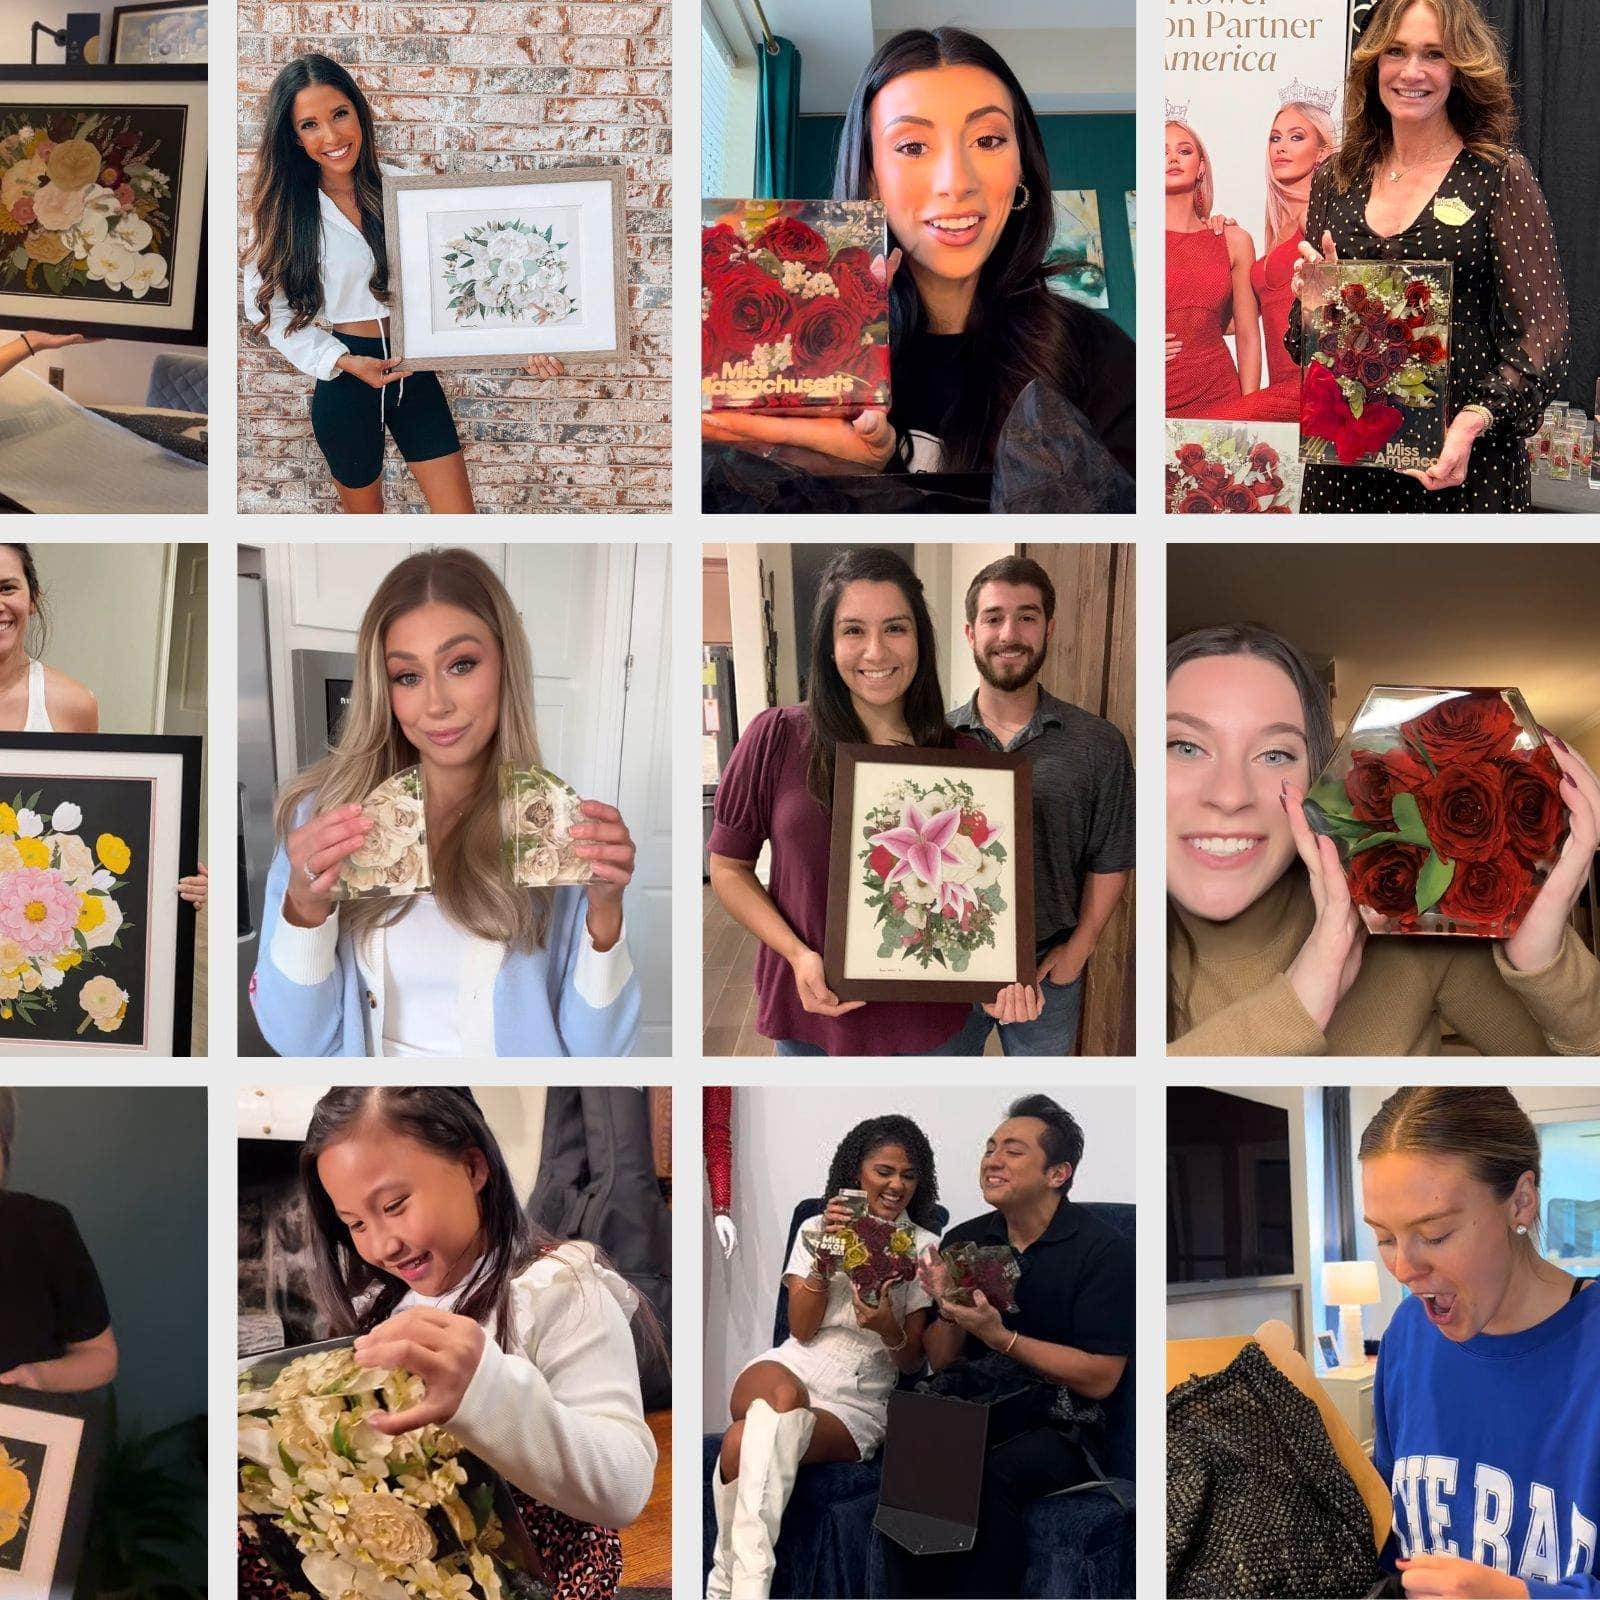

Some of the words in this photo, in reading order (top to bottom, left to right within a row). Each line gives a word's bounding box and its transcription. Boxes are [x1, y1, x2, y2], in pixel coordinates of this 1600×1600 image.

[1206, 10, 1323, 39] Partner
[722, 360, 769, 380] Miss
[1386, 441, 1420, 457] Miss
[1375, 452, 1439, 468] America
[822, 1234, 847, 1245] Miss
[1392, 1455, 1459, 1559] HE
